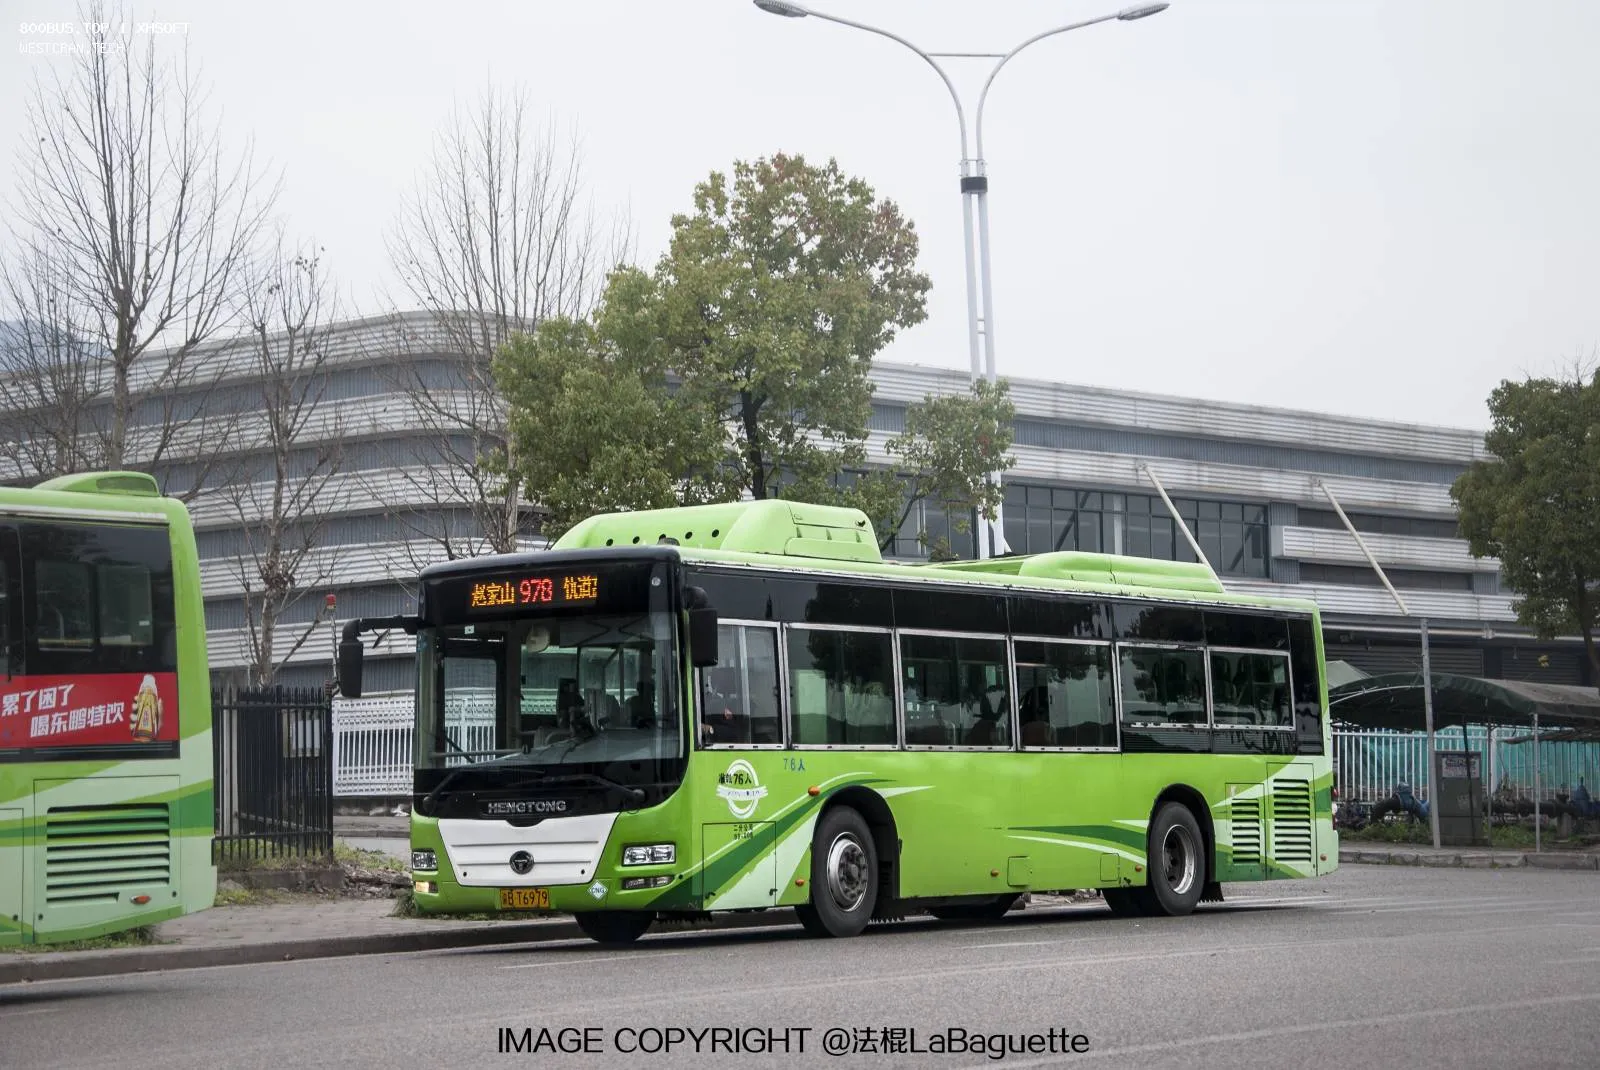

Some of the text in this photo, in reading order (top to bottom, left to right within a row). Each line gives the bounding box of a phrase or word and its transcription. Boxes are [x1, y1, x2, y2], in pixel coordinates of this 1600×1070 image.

[519, 578, 553, 603] 978
[2, 683, 75, 717] 累了困了
[30, 702, 125, 738] 喝东鹏特饮
[487, 800, 567, 814] HENGTONG
[591, 886, 605, 894] CNG
